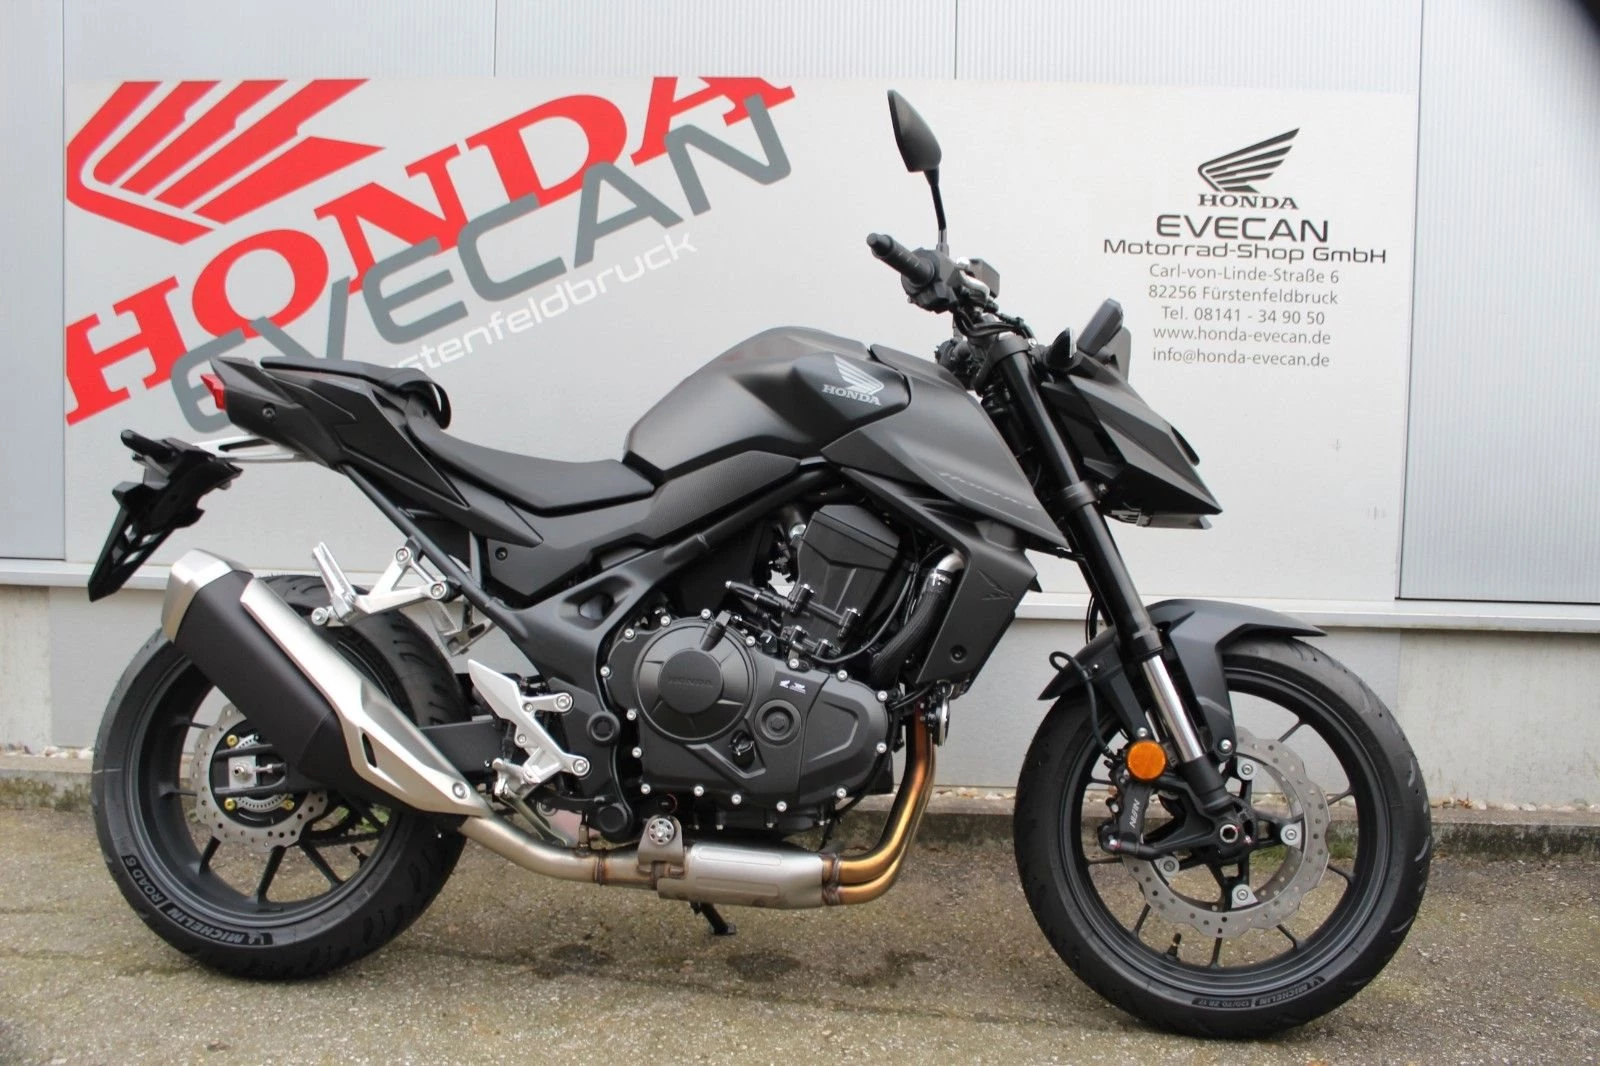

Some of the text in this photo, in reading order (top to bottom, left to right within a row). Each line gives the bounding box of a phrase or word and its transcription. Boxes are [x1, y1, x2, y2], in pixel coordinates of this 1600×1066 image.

[1197, 194, 1299, 210] HONDA
[1155, 213, 1329, 243] EVECAN
[66, 76, 795, 426] HONDA
[1103, 239, 1387, 264] Motorrad-Shop GmbH
[171, 93, 791, 433] EVECAN
[1149, 263, 1340, 284] Carl-von-Linde-Straße 6
[1148, 284, 1339, 305] 82256 Fürstenfeldbruck
[1161, 305, 1188, 320] Tel.
[1193, 306, 1241, 322] 08141
[1258, 309, 1277, 323] 34
[1282, 310, 1301, 324] 90
[1306, 311, 1326, 325] 50
[1152, 327, 1332, 345] www.honda-evecan.de
[1152, 347, 1330, 367] info@honda-evecan.de
[821, 384, 882, 406] HONDA
[132, 869, 164, 903] ROAD
[167, 906, 245, 944] MICHELIN
[1258, 983, 1308, 1006] MICHELIN
